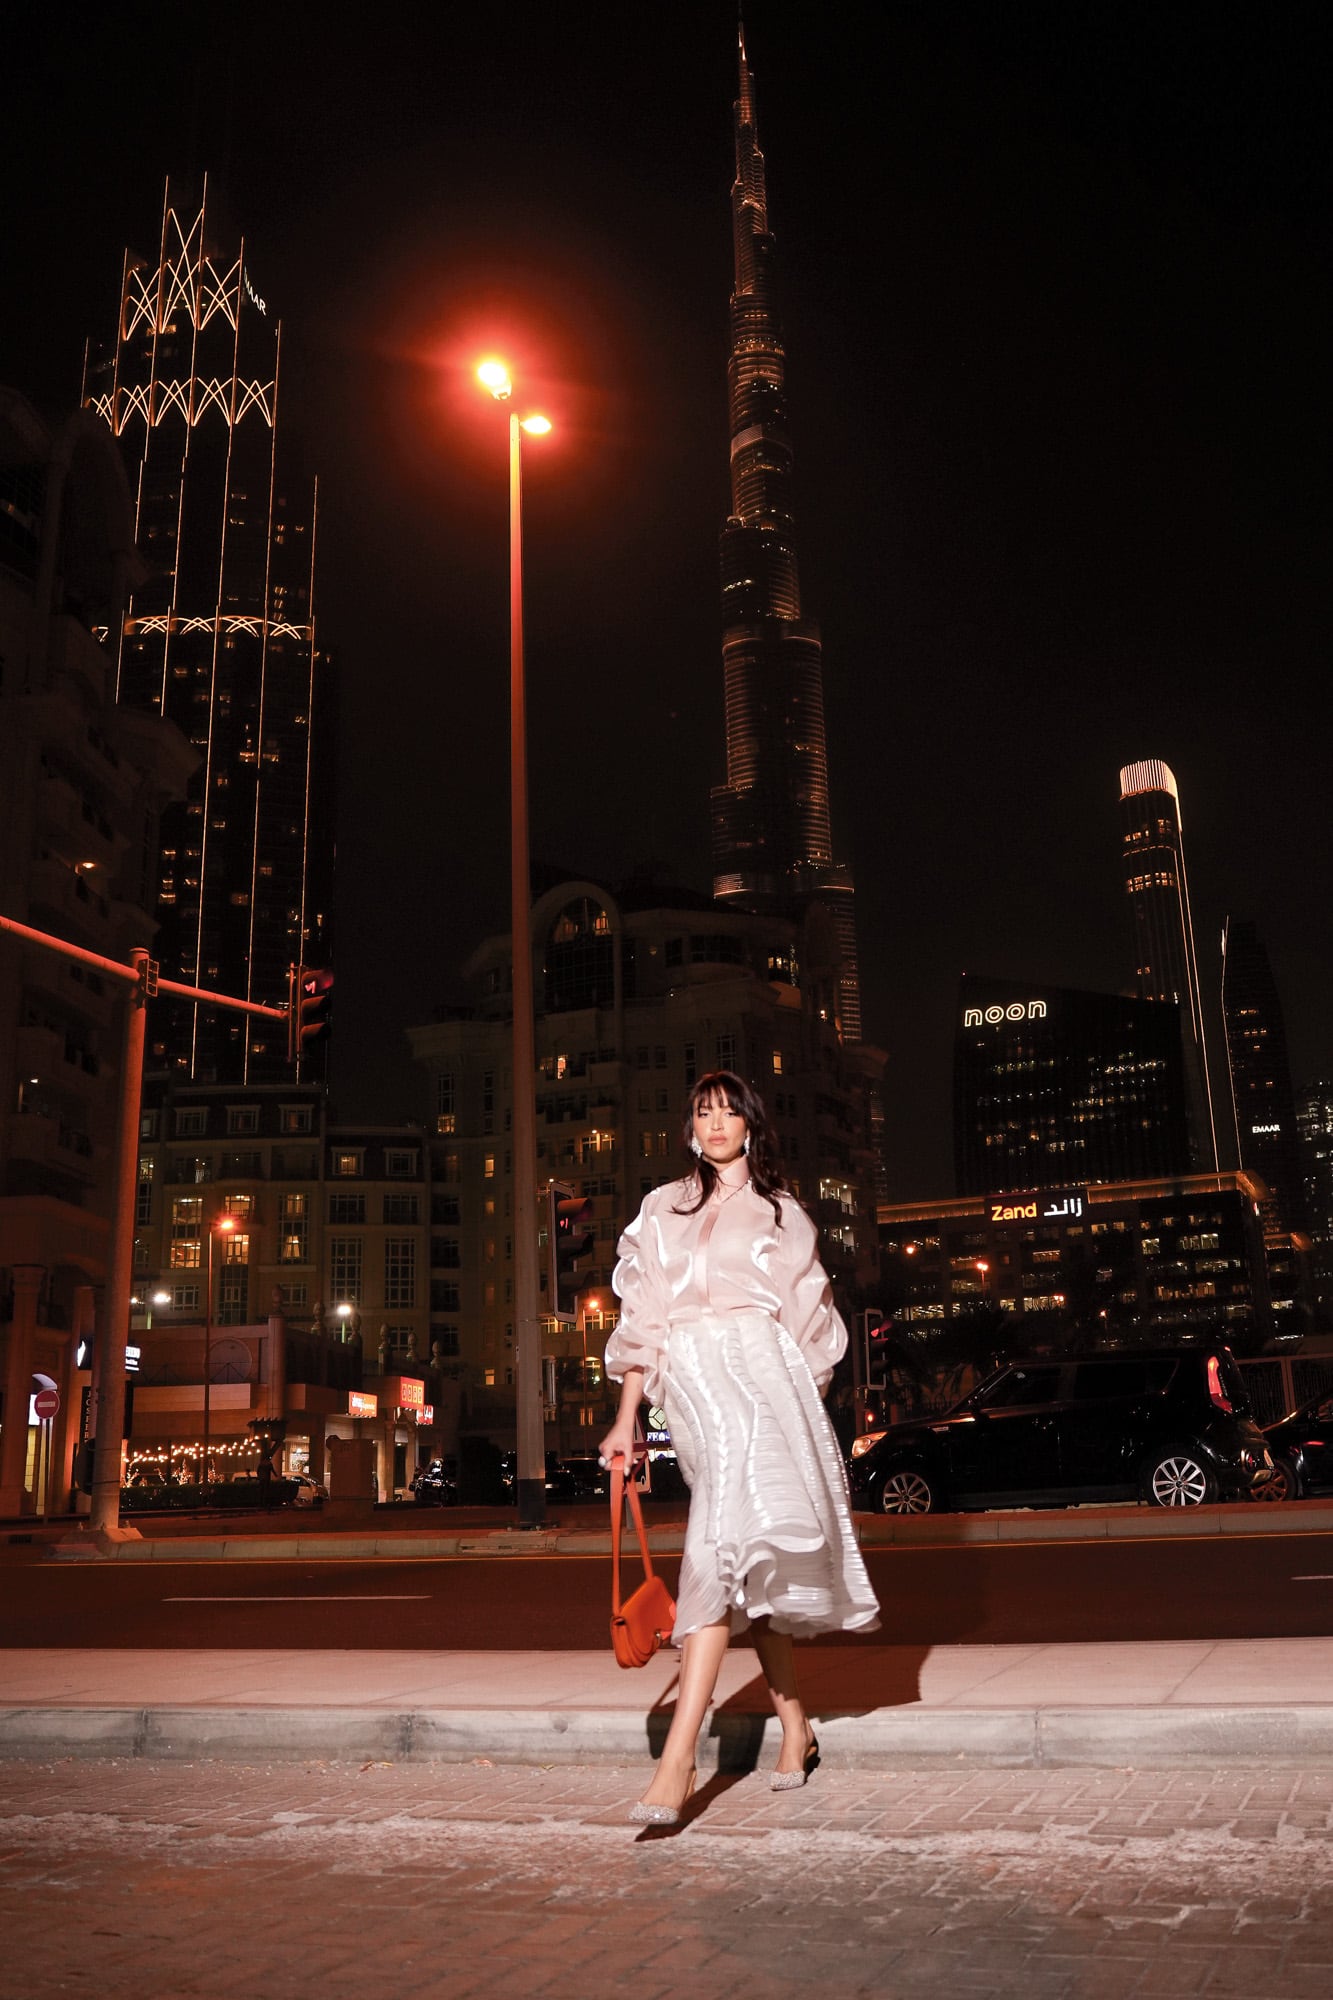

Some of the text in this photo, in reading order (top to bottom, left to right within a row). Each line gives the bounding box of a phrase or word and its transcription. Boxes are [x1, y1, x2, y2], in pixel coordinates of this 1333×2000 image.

[964, 1001, 1047, 1028] noon
[1252, 1124, 1281, 1134] EMAAR
[991, 1202, 1037, 1221] Zand
